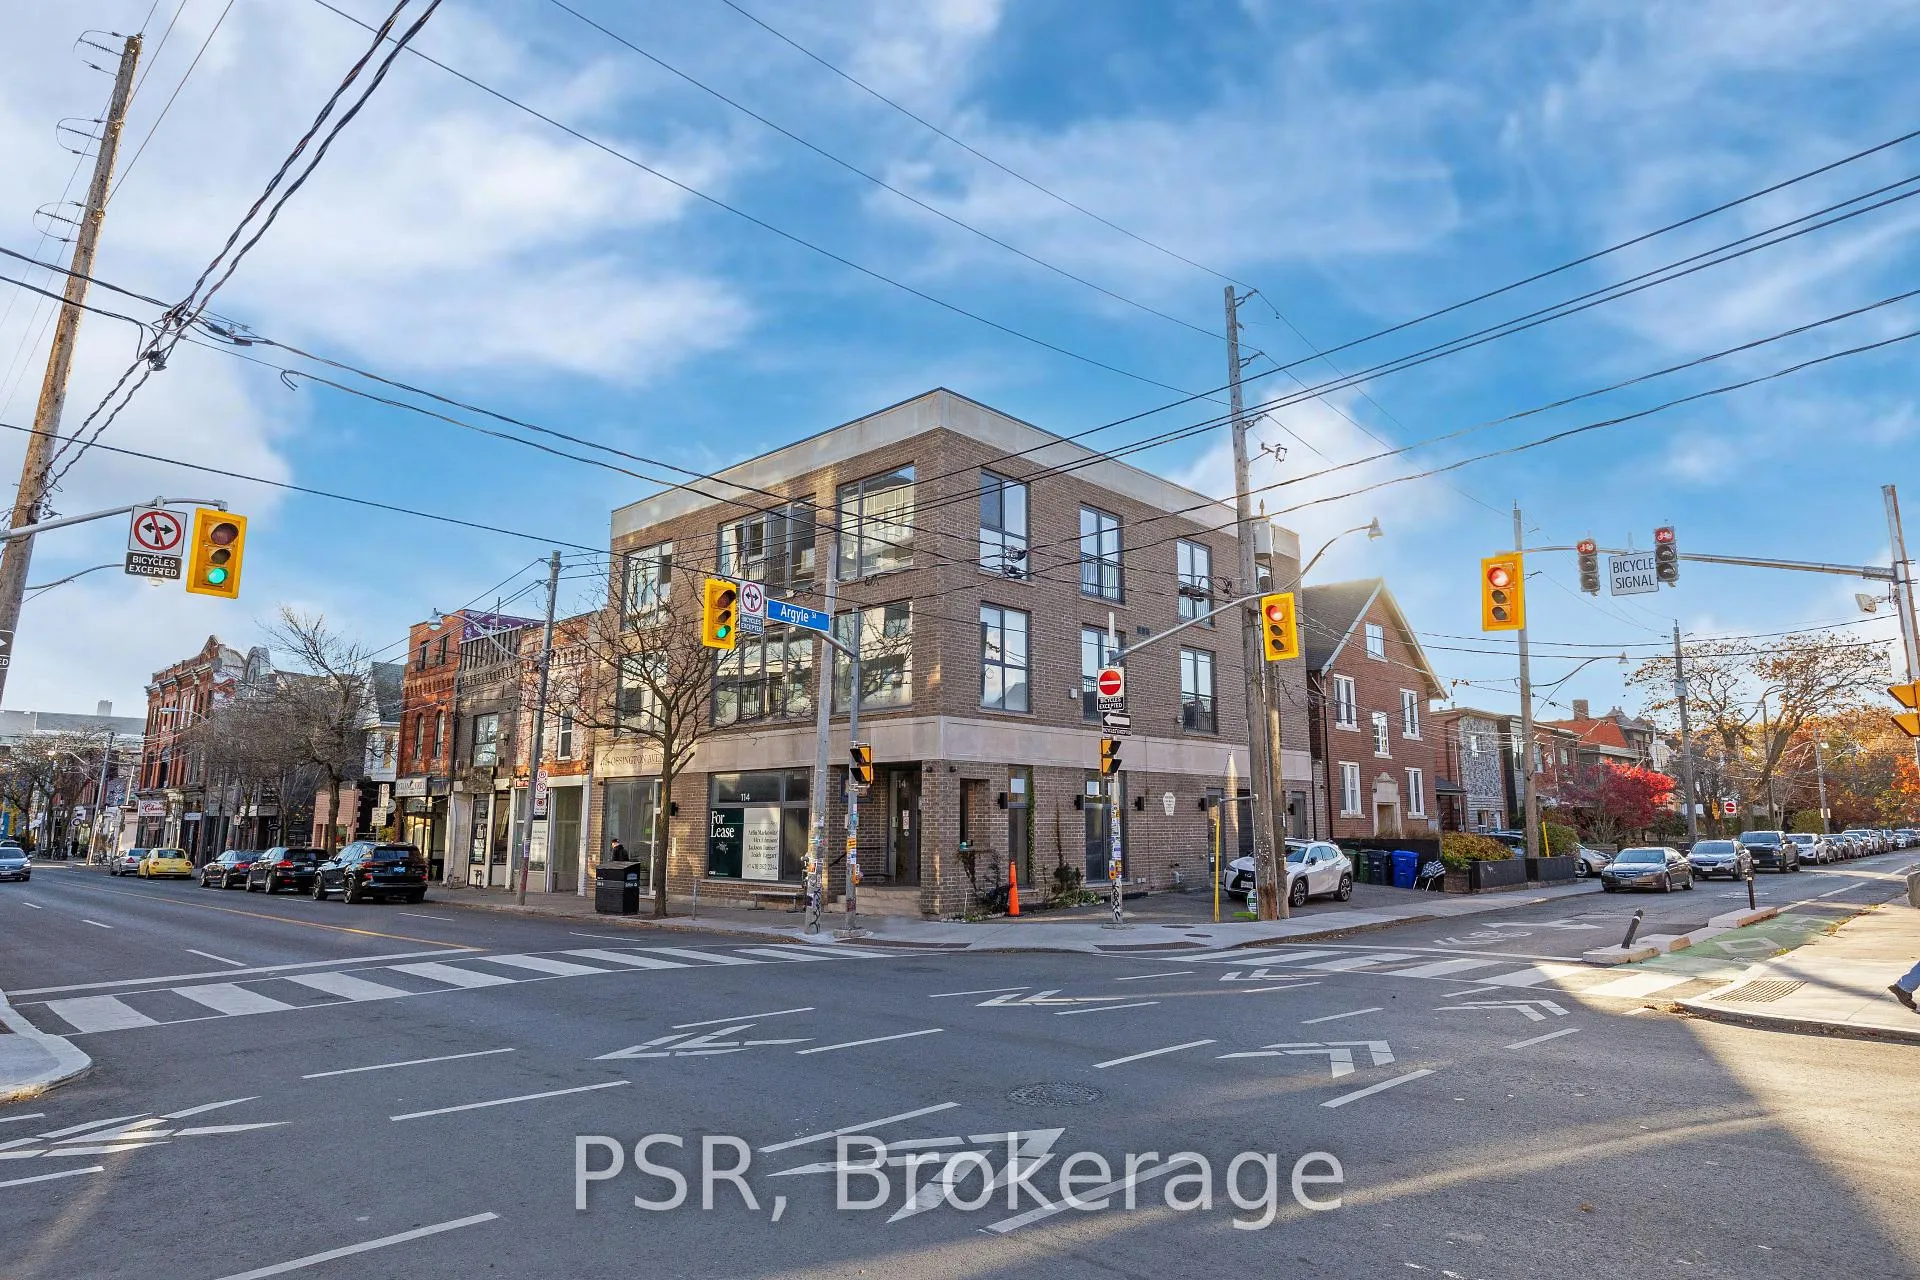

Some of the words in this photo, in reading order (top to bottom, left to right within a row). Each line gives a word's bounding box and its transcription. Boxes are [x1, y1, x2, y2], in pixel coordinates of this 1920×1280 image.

[132, 555, 176, 568] BICYCLES
[1612, 558, 1655, 573] BICYCLE
[129, 565, 177, 577] EXCEPTED
[1615, 574, 1655, 589] SIGNAL
[741, 615, 762, 623] BICYCLES
[780, 605, 809, 623] Argyle
[741, 622, 763, 632] EXCEPTED
[612, 755, 647, 766] OSSINGTON
[740, 792, 750, 801] 114
[711, 810, 725, 825] For
[710, 824, 735, 838] Lease
